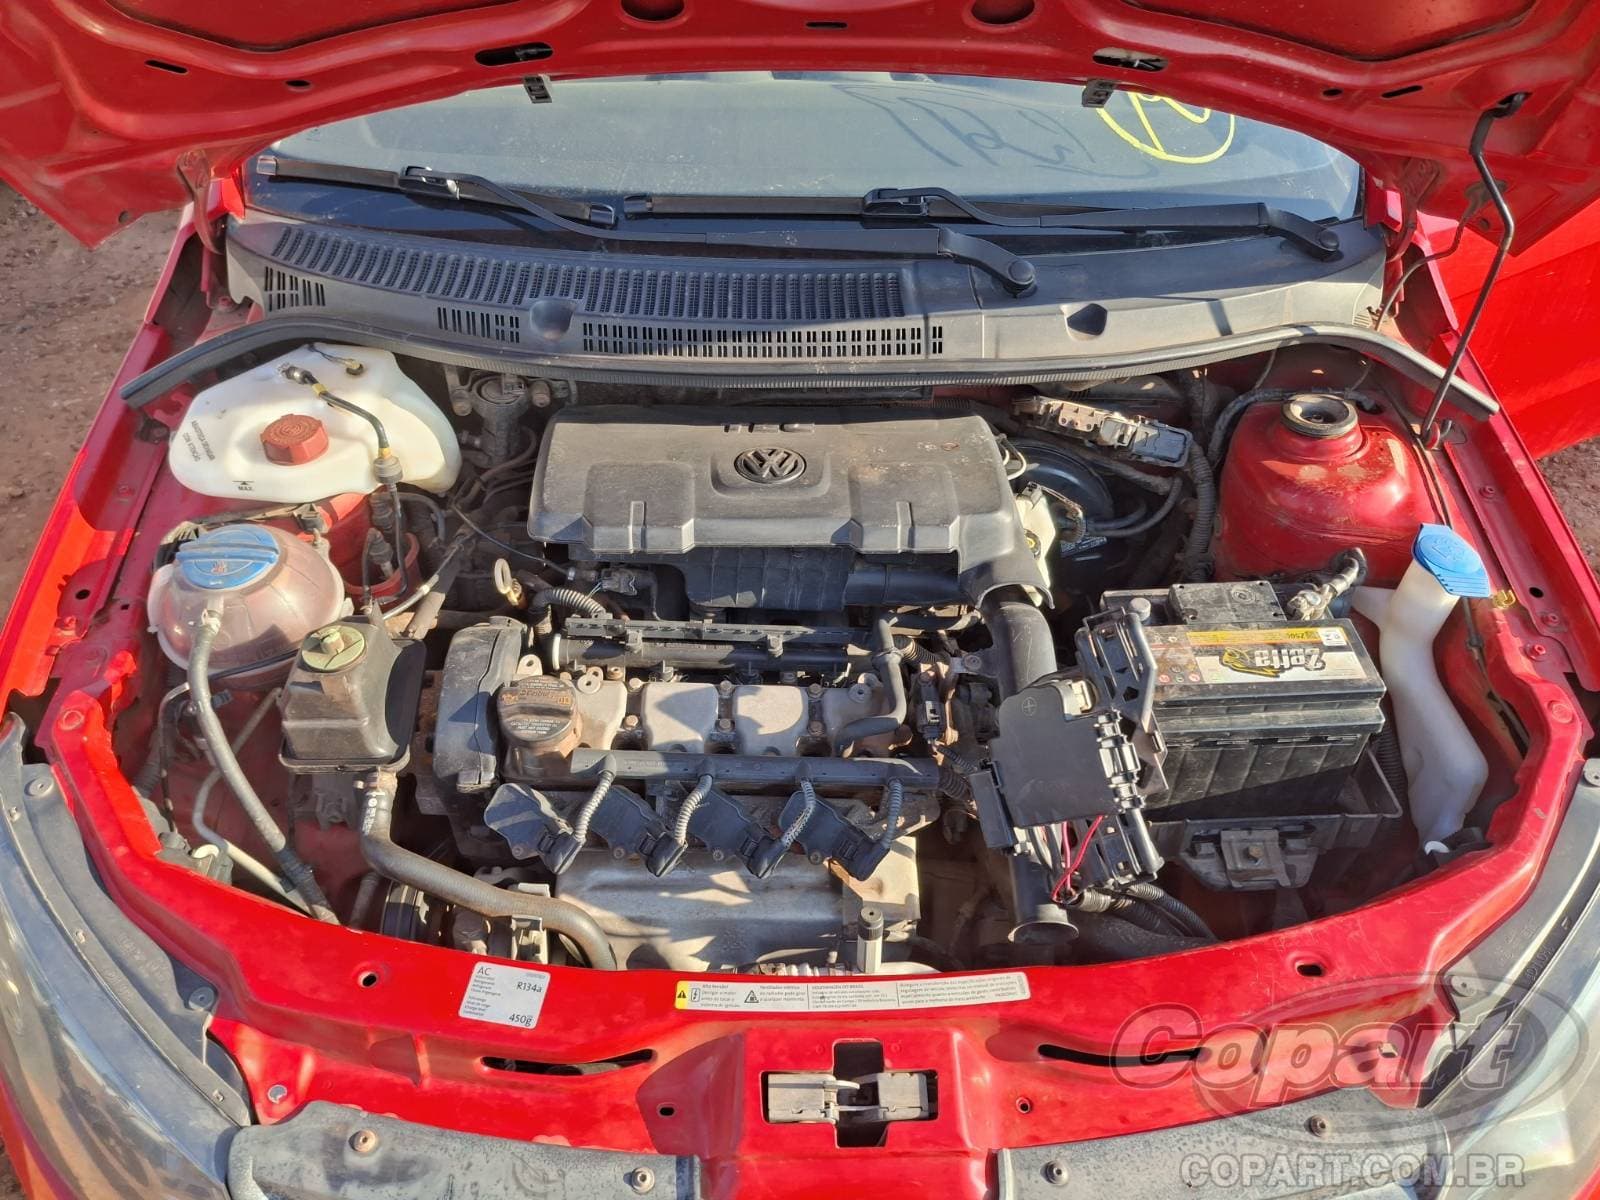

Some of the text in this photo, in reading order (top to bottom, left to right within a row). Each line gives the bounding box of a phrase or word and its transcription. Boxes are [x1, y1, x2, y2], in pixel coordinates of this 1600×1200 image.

[477, 966, 492, 976] AC
[516, 981, 543, 993] R134a
[508, 1013, 534, 1027] 450g
